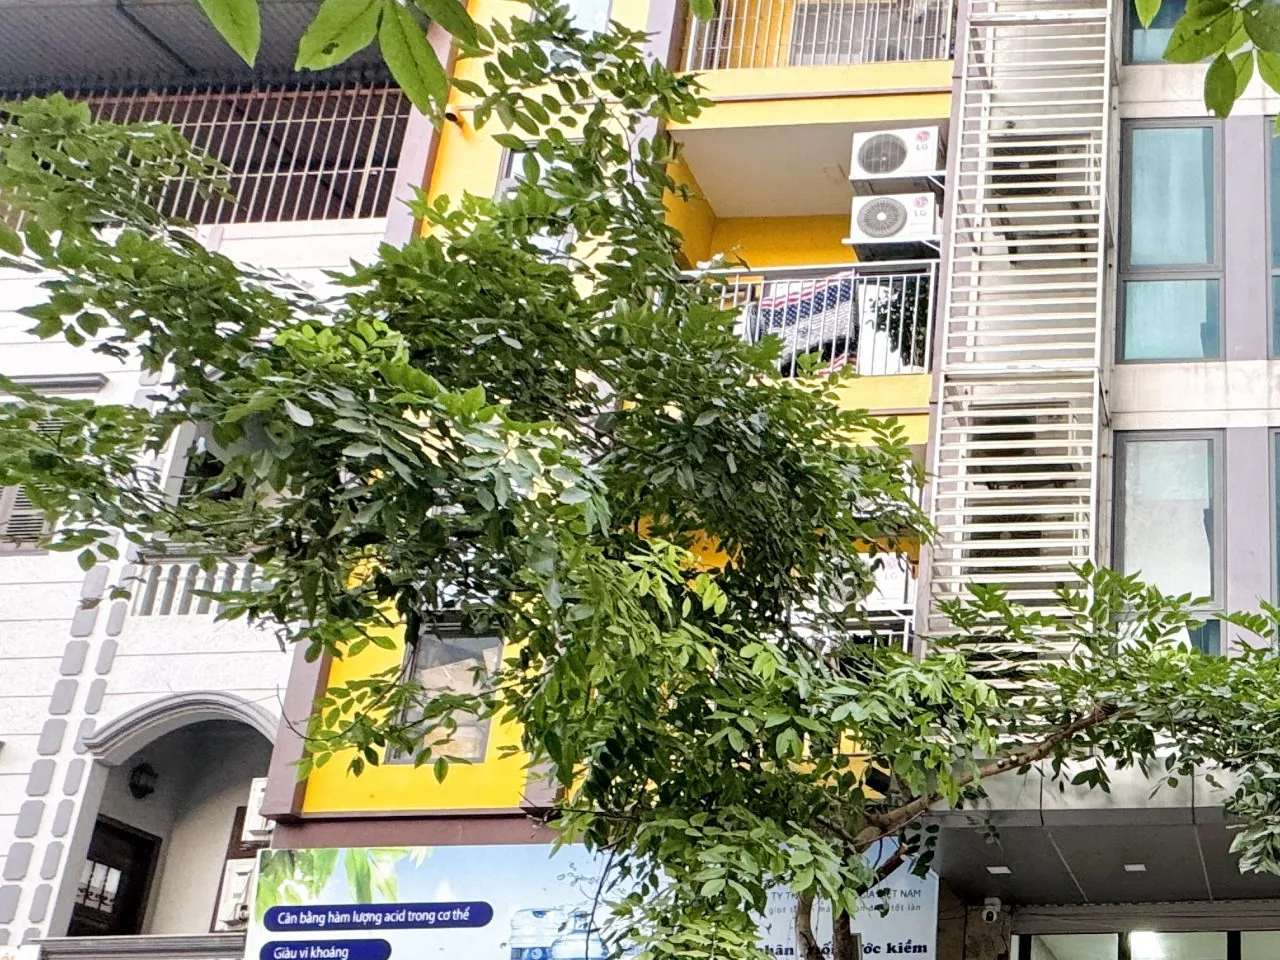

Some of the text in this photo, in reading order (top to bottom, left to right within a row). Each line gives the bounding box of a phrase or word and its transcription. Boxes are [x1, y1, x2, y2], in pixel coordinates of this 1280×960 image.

[900, 889, 921, 899] NAM
[277, 911, 298, 925] Cân
[299, 910, 326, 927] bằng
[327, 910, 351, 924] hàm
[352, 910, 382, 926] lượng
[383, 908, 406, 922] acid
[407, 910, 436, 924] trong
[437, 910, 451, 921] cơ
[273, 945, 349, 960] Giàu vi khoáng
[886, 939, 928, 954] kiềm
